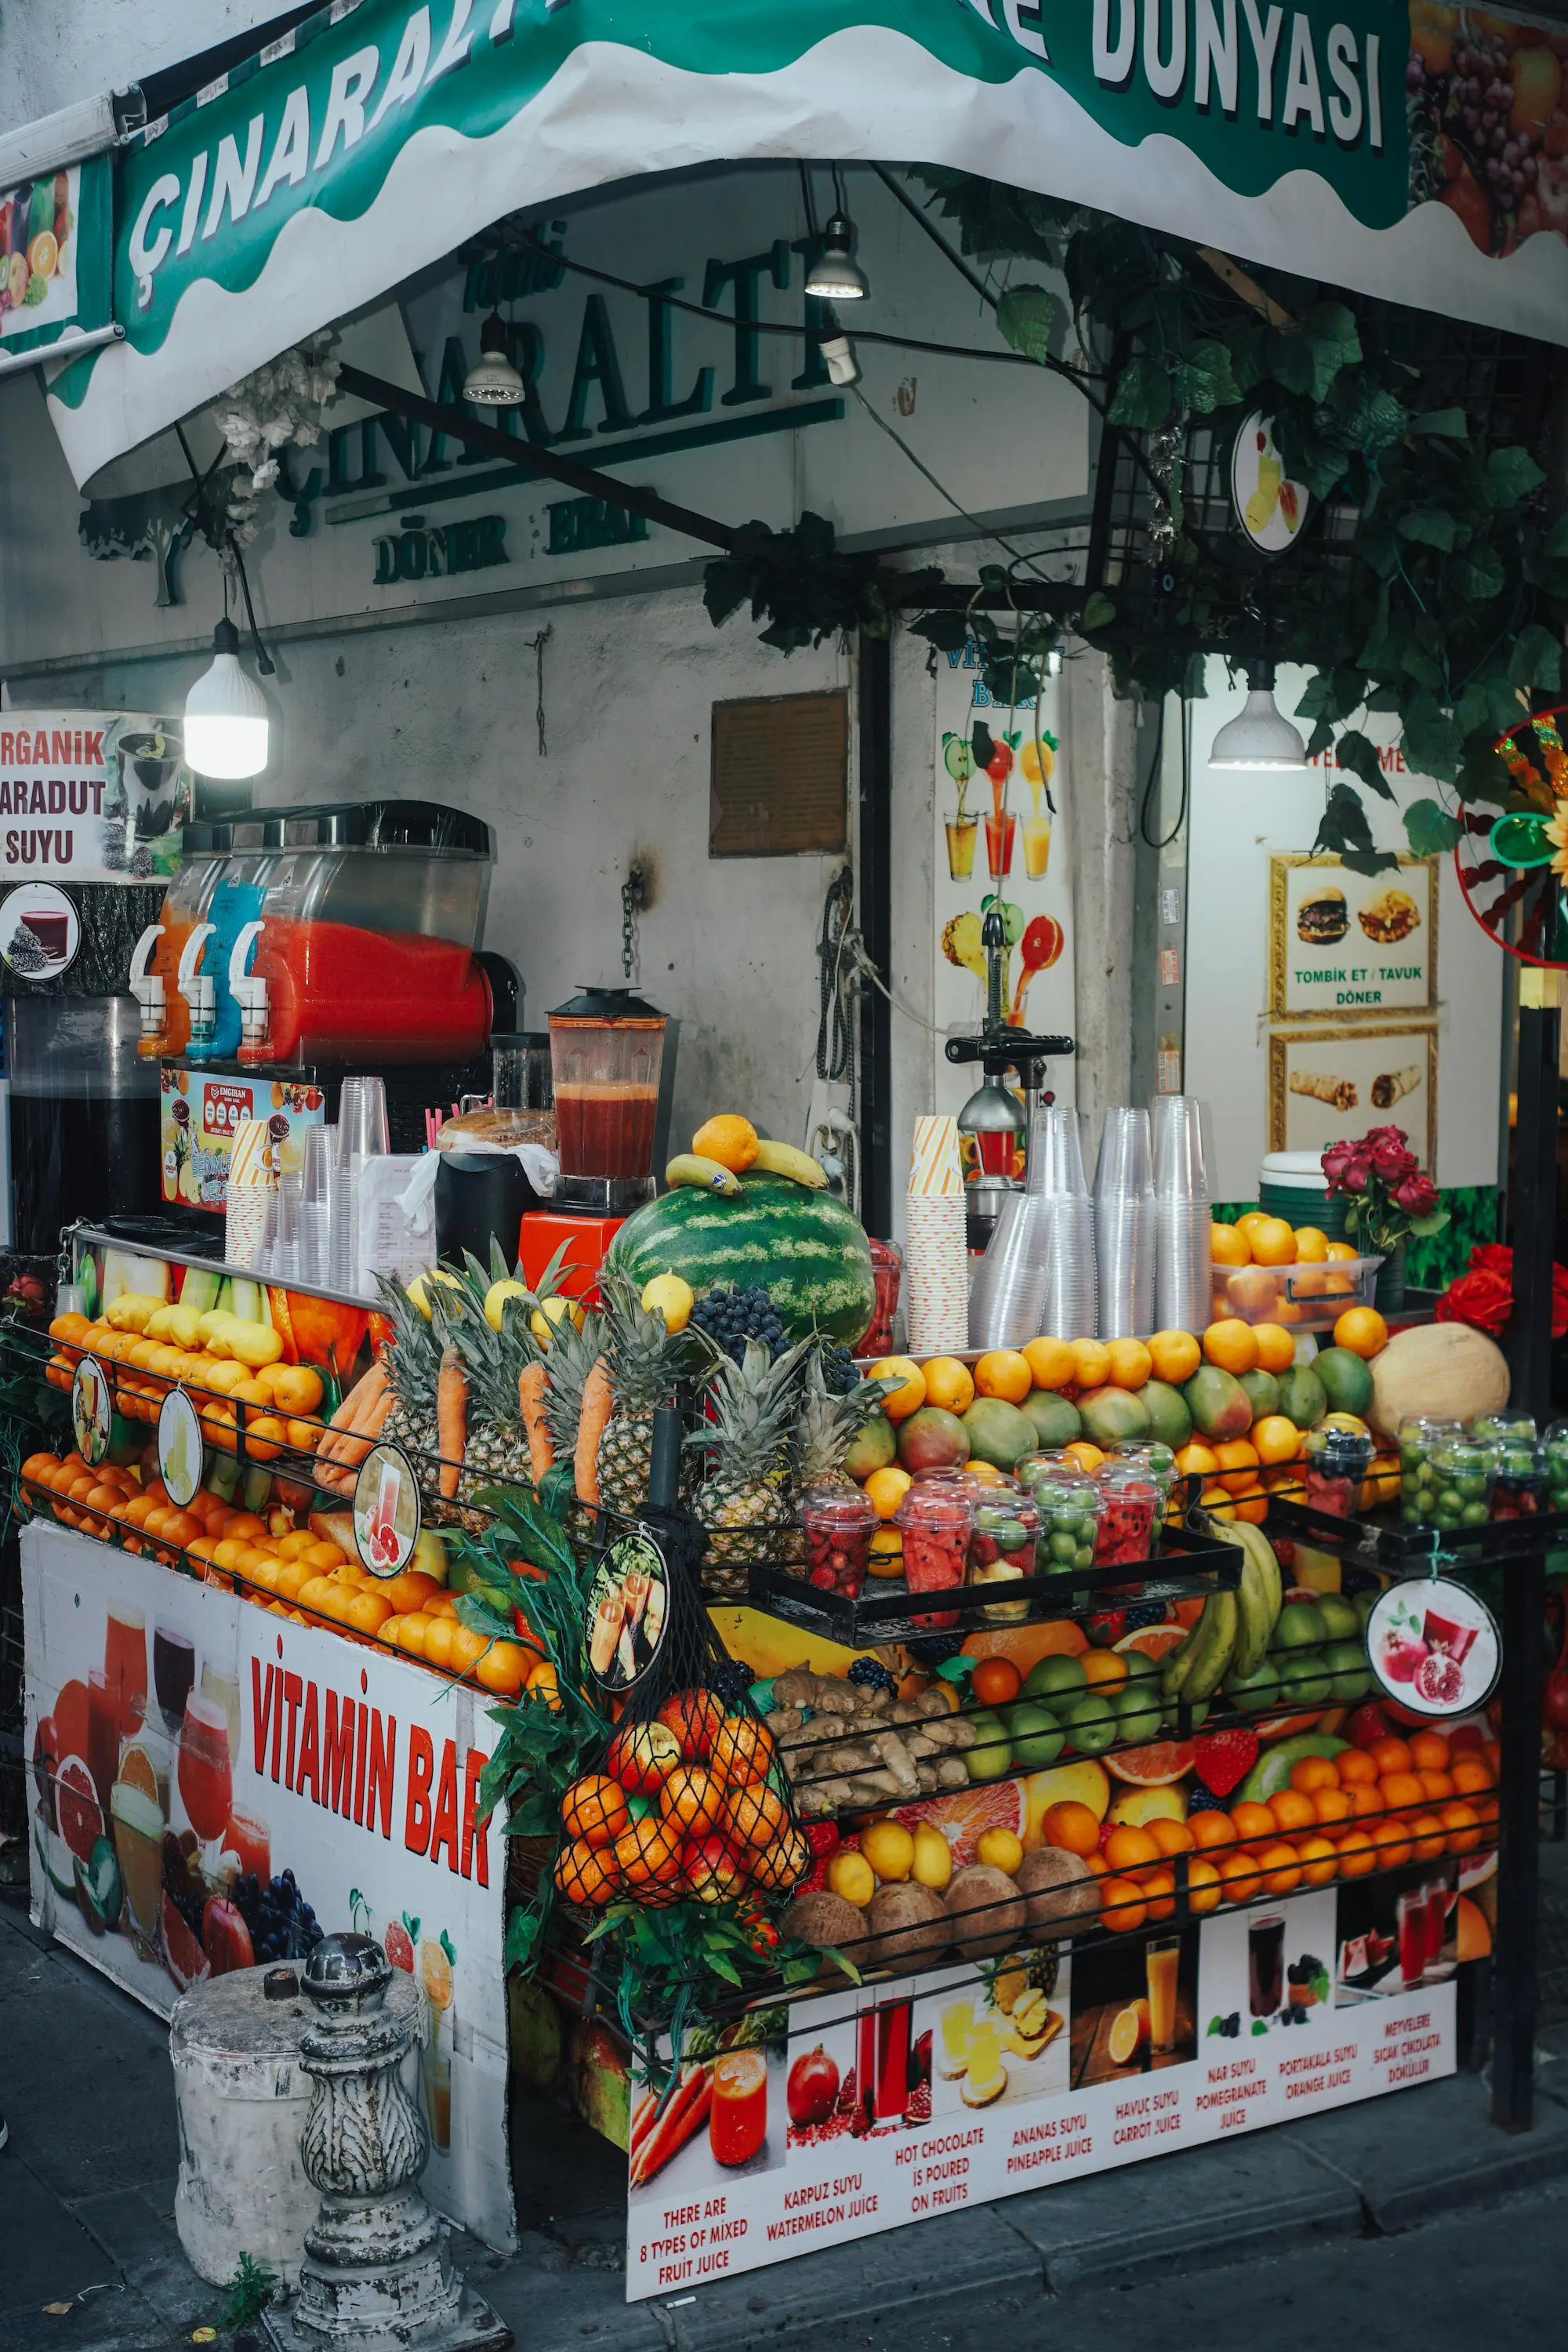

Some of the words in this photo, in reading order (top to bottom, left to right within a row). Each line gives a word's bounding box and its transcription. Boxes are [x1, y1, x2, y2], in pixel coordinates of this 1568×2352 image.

[128, 0, 571, 308] ÇINARAL
[5, 829, 73, 864] SUYU
[1351, 969, 1368, 982] ET
[1379, 967, 1422, 980] TAVUK
[1337, 991, 1381, 1005] DÖNER
[252, 1634, 397, 1841] VİTAMİN
[405, 1723, 492, 1890] BAR
[1334, 2043, 1359, 2063] SUYU
[1207, 2068, 1229, 2085] NAR
[1231, 2058, 1256, 2080] SUYU
[1153, 2089, 1179, 2111] SUYU
[1196, 2079, 1267, 2111] POMEGRANATE
[1286, 2075, 1325, 2100] ORANGE
[1012, 2121, 1057, 2148] ANANAS
[1060, 2113, 1087, 2136] SUYU
[1113, 2122, 1152, 2146] CARROT
[895, 2144, 919, 2166] HOT
[921, 2127, 985, 2158] CHOCOLATE
[1007, 2144, 1062, 2175] PINEAPPLE
[927, 2158, 970, 2183] POURED
[784, 2182, 829, 2210] KARPUZ
[833, 2172, 862, 2197] SUYU
[912, 2194, 928, 2213] ON
[664, 2204, 700, 2229] THERE
[704, 2197, 726, 2217] ARE
[767, 2205, 844, 2241] WATERMELON
[640, 2245, 647, 2263] 8
[652, 2234, 686, 2259] TYPES
[690, 2229, 706, 2249] OF
